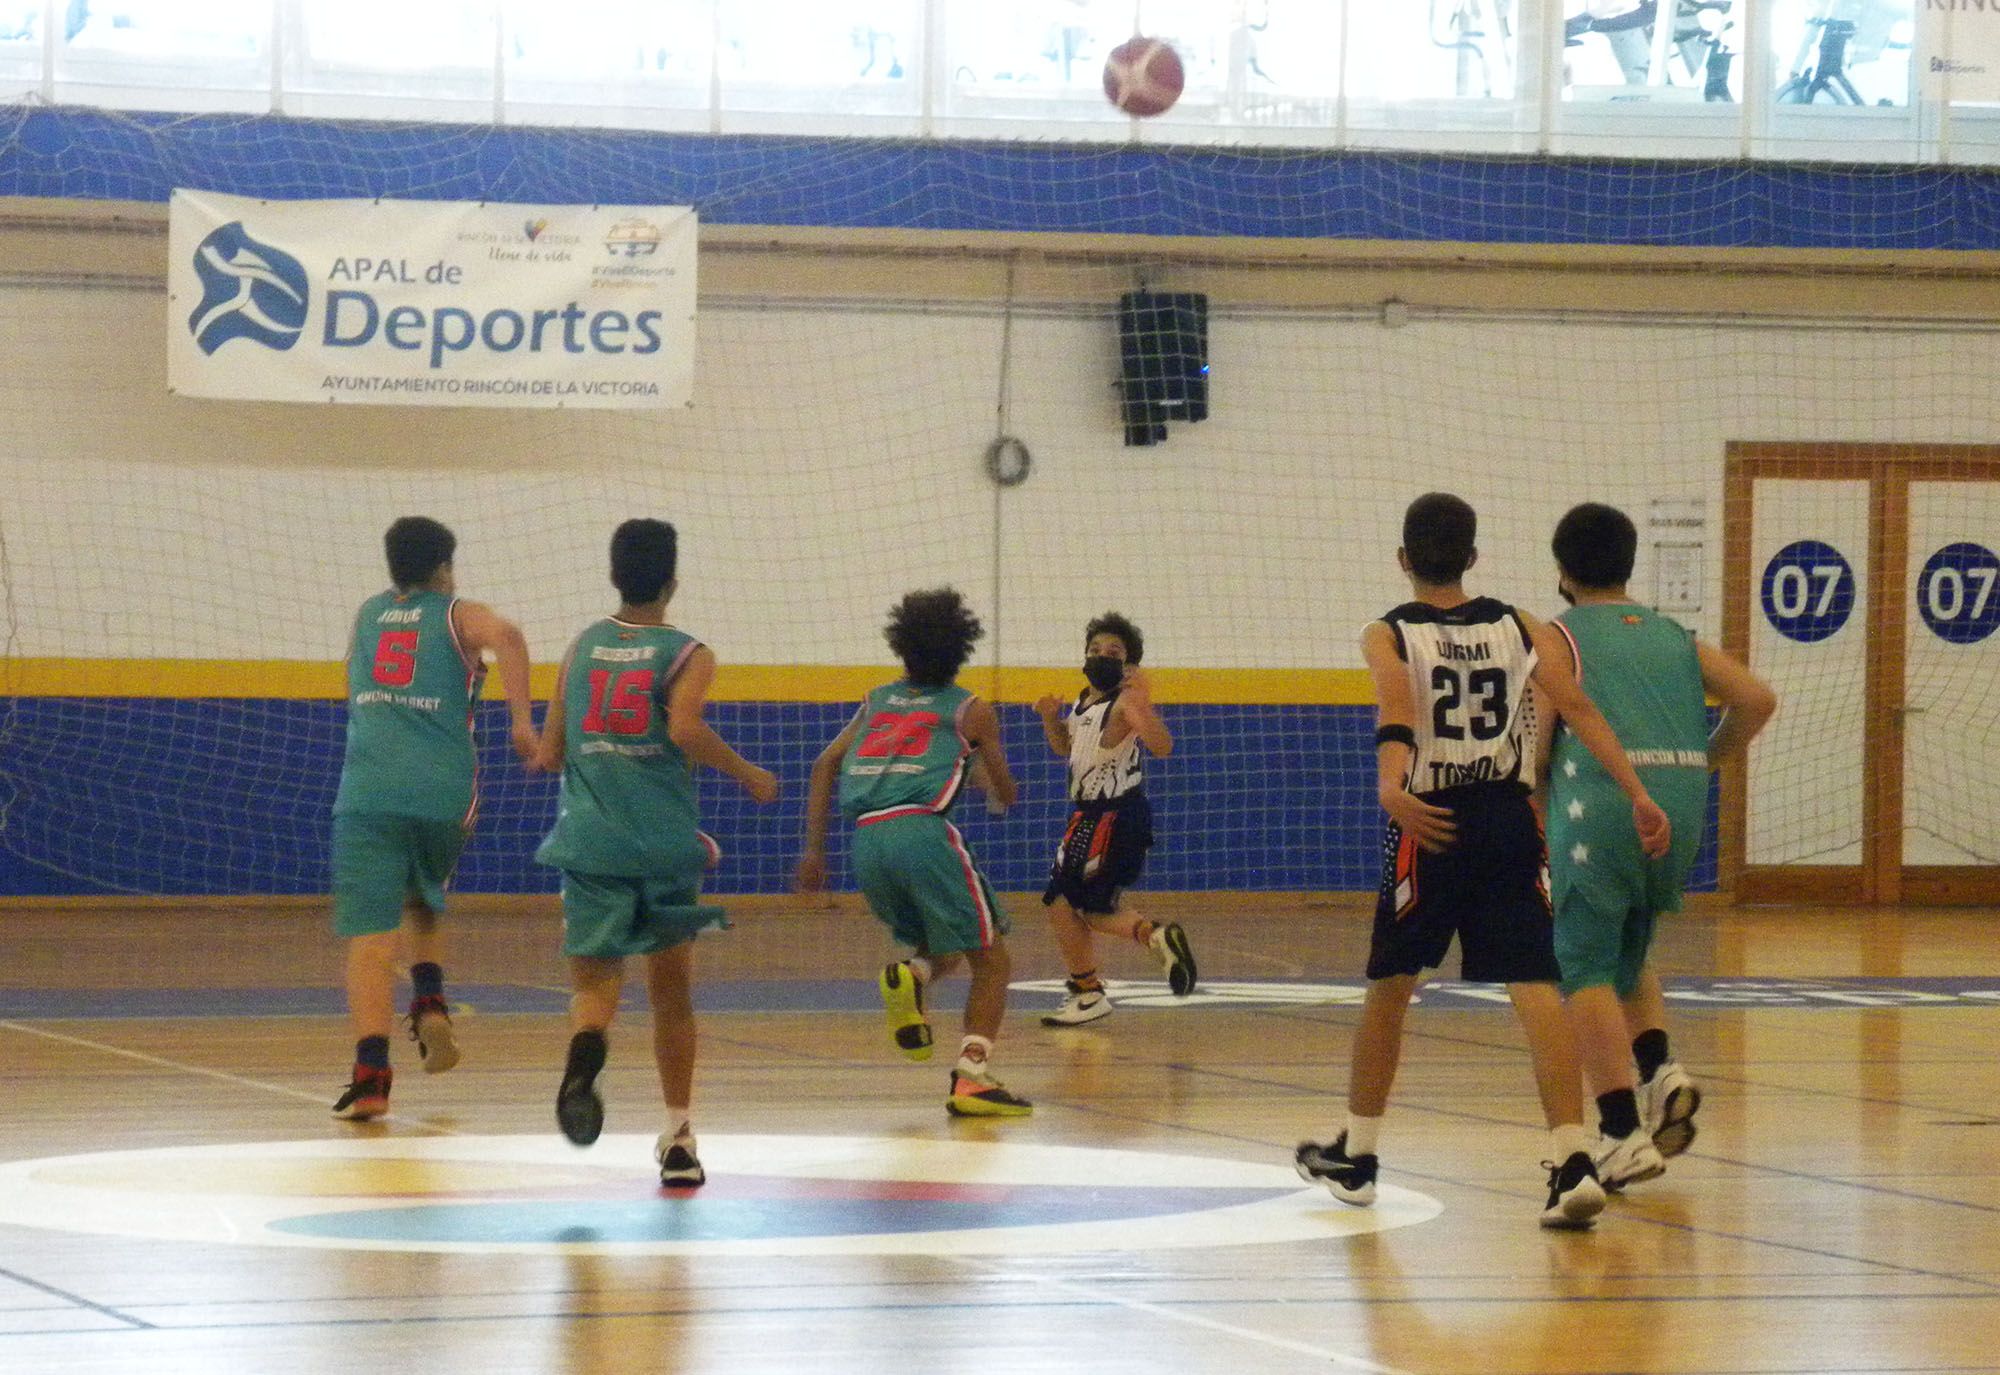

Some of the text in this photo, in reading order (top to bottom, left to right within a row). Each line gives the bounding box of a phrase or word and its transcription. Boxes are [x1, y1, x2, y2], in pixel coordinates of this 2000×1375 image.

[328, 257, 463, 285] APAL de
[322, 290, 662, 369] Deportes
[320, 375, 660, 396] AYUNTAMIENTO RINCÓN DE LA VICTORIA
[1773, 565, 1842, 619] 07
[1928, 567, 1998, 621] 07
[372, 631, 420, 689] 5
[582, 668, 656, 735] 15
[1431, 665, 1509, 740] 23
